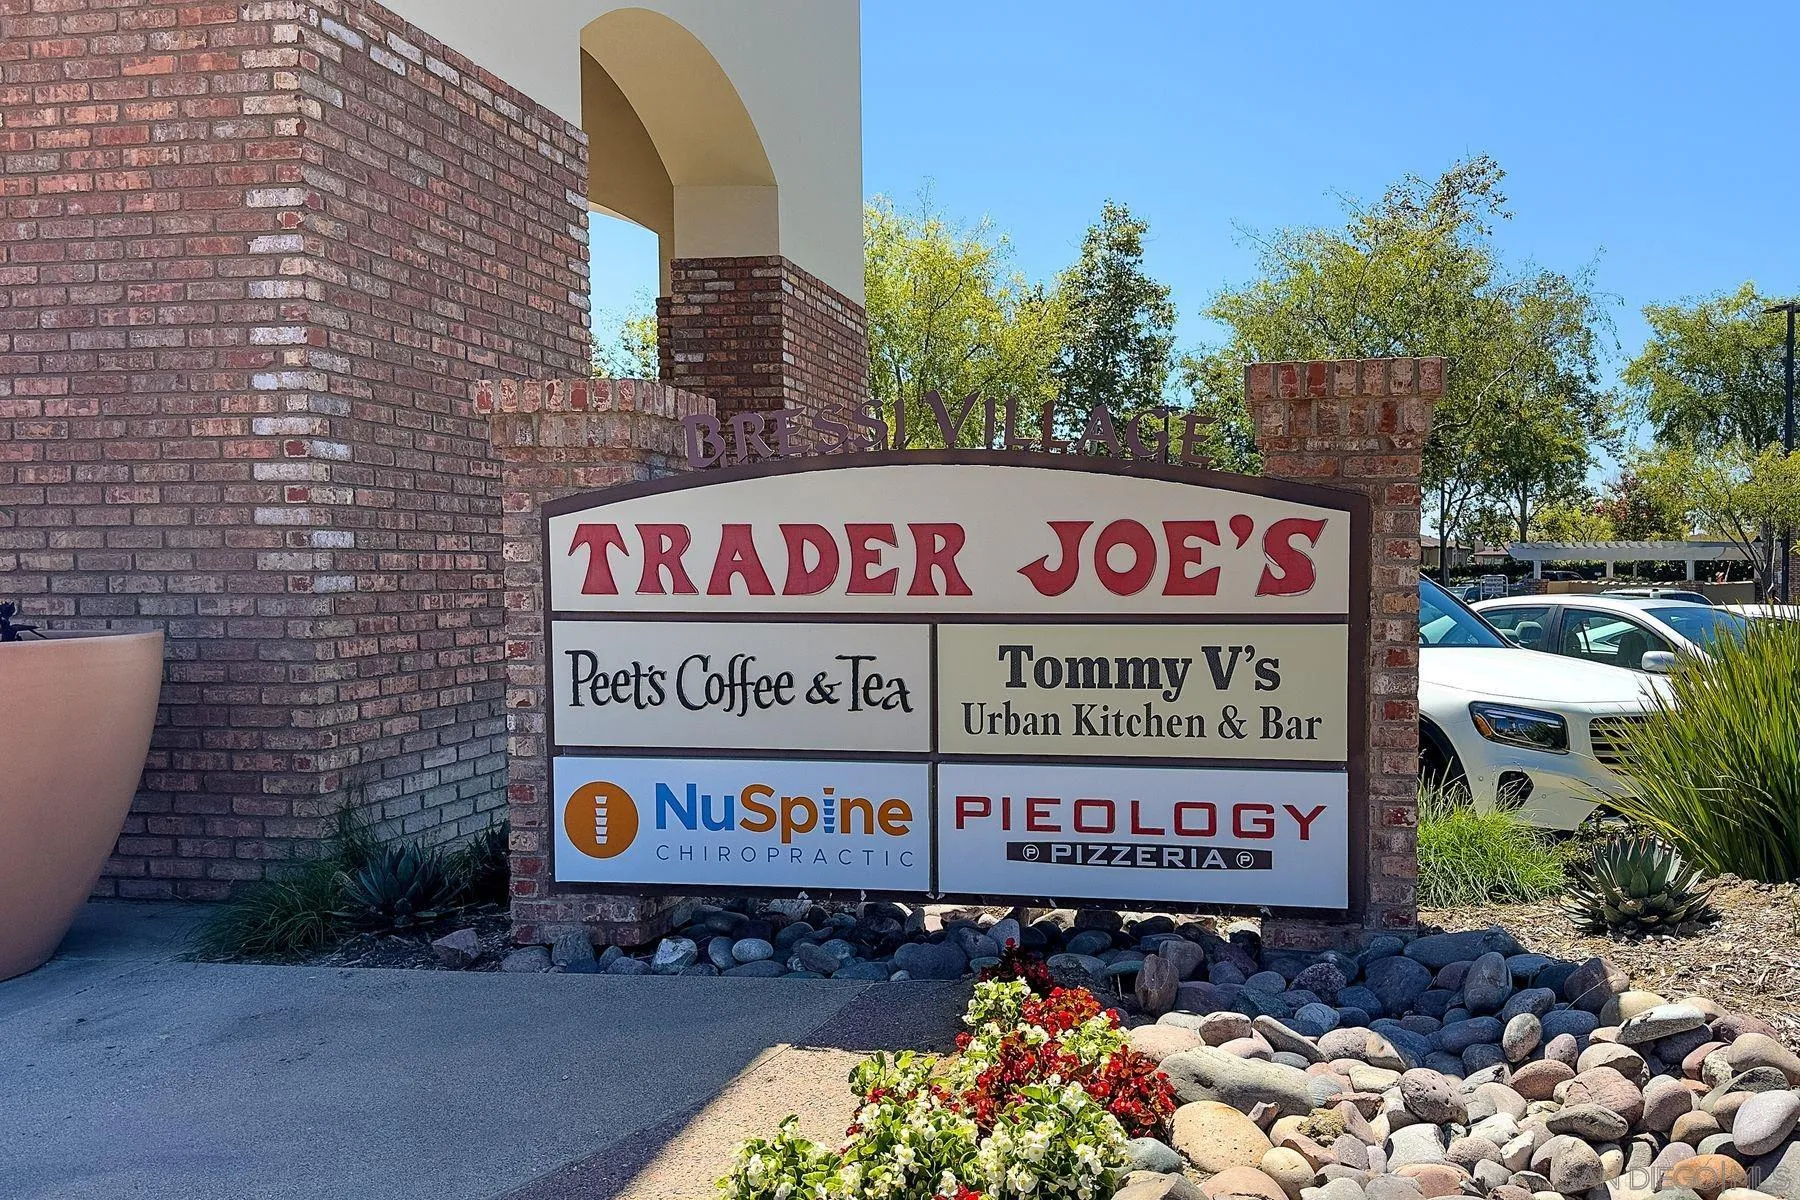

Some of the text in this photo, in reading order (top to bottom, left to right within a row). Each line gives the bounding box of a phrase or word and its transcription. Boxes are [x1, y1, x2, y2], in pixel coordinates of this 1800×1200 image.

[682, 389, 1218, 468] BRESSI VILLAGE
[568, 514, 1328, 597] TRADER JOE'S
[565, 649, 914, 717] Peet's Coffee & Tea
[998, 644, 1281, 702] Tommy V's
[961, 701, 1323, 741] Urban Kitchen & Bar
[655, 782, 914, 844] NuSpine
[955, 795, 1328, 840] PIEOLOGY
[656, 845, 914, 868] CHIROPRACTIC
[1051, 844, 1228, 869] PIZZERIA
